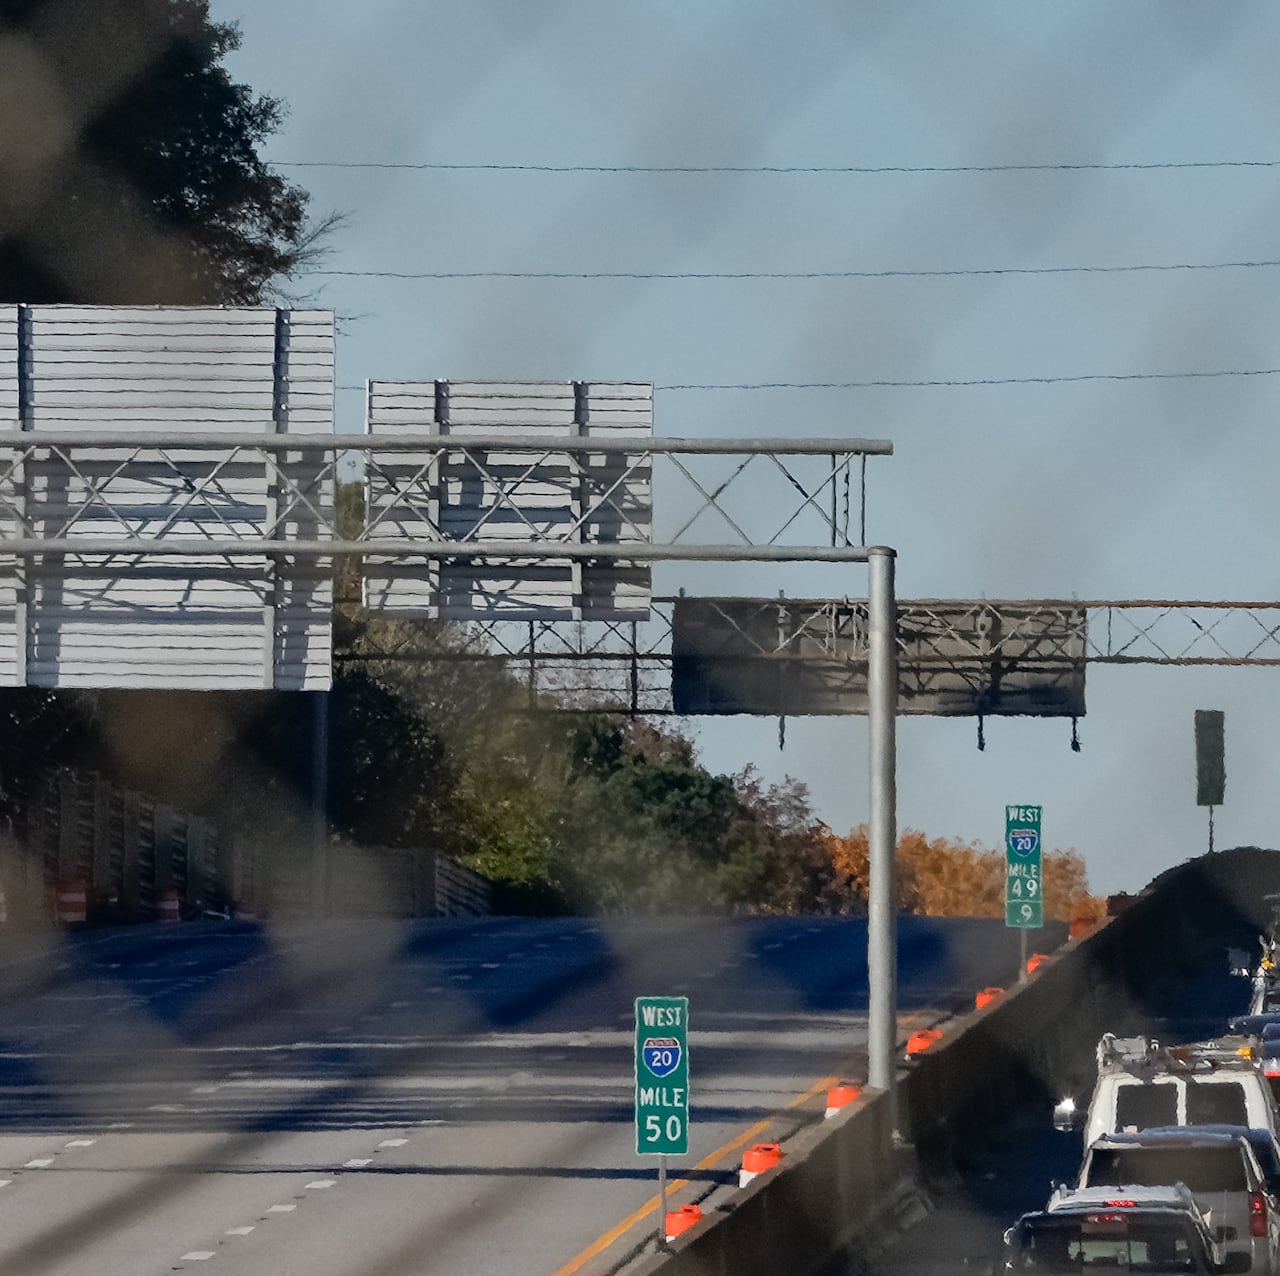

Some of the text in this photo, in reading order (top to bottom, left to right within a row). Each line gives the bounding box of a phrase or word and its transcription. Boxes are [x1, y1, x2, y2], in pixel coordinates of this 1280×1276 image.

[1007, 807, 1039, 823] WEST
[1016, 837, 1032, 851] 20
[1008, 864, 1039, 879] MILE
[1012, 878, 1038, 898] 49
[641, 1006, 682, 1027] WEST
[651, 1050, 673, 1067] 20
[640, 1086, 685, 1108] MILE
[645, 1115, 682, 1142] 50
